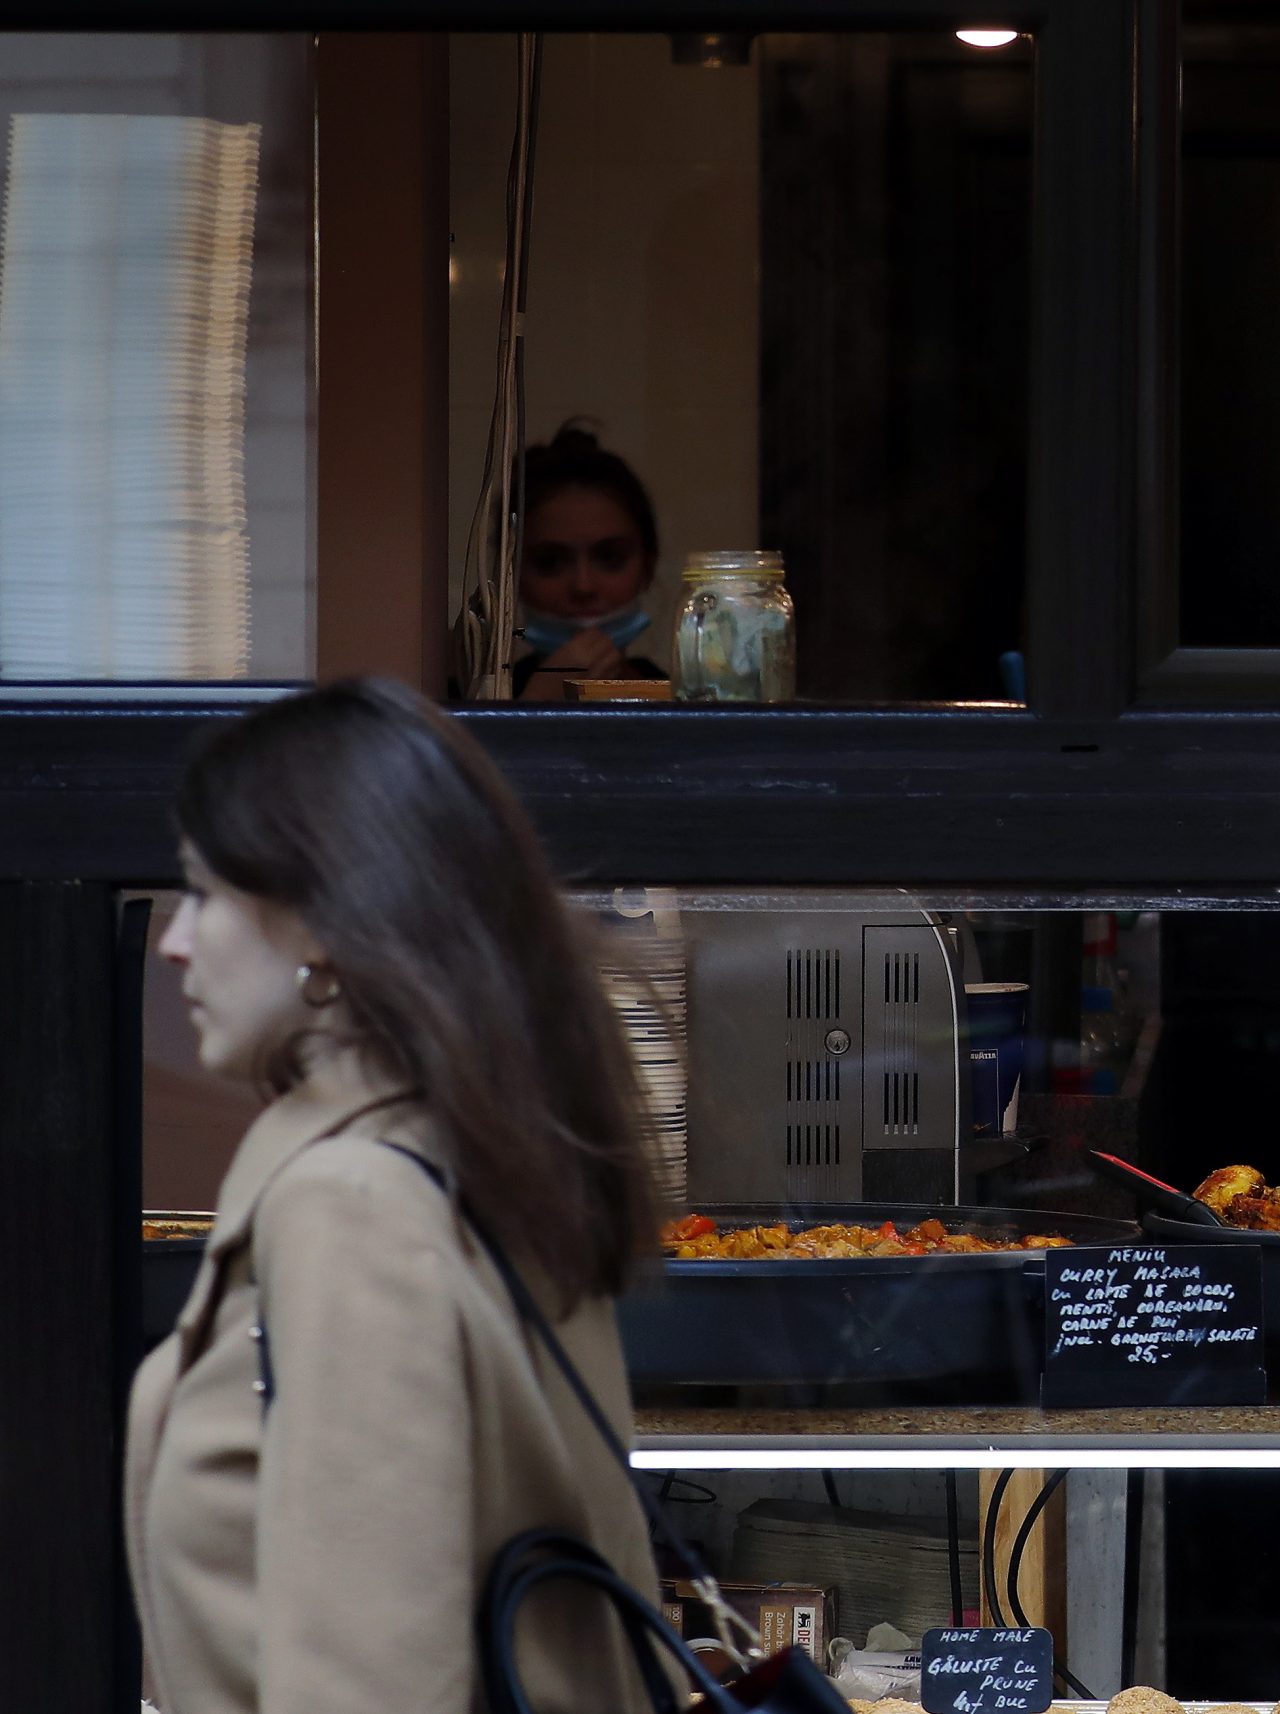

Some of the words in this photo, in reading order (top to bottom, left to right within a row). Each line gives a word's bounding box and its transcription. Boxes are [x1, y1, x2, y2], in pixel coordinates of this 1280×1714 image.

[1060, 1268, 1118, 1286] CURRY
[1144, 1284, 1168, 1298] DE
[1062, 1317, 1112, 1332] CARNE
[1117, 1316, 1138, 1329] DE
[764, 1612, 773, 1641] Brown
[940, 1629, 980, 1642] HOME
[992, 1629, 1036, 1642] MADE
[979, 1674, 1039, 1692] PRUNE
